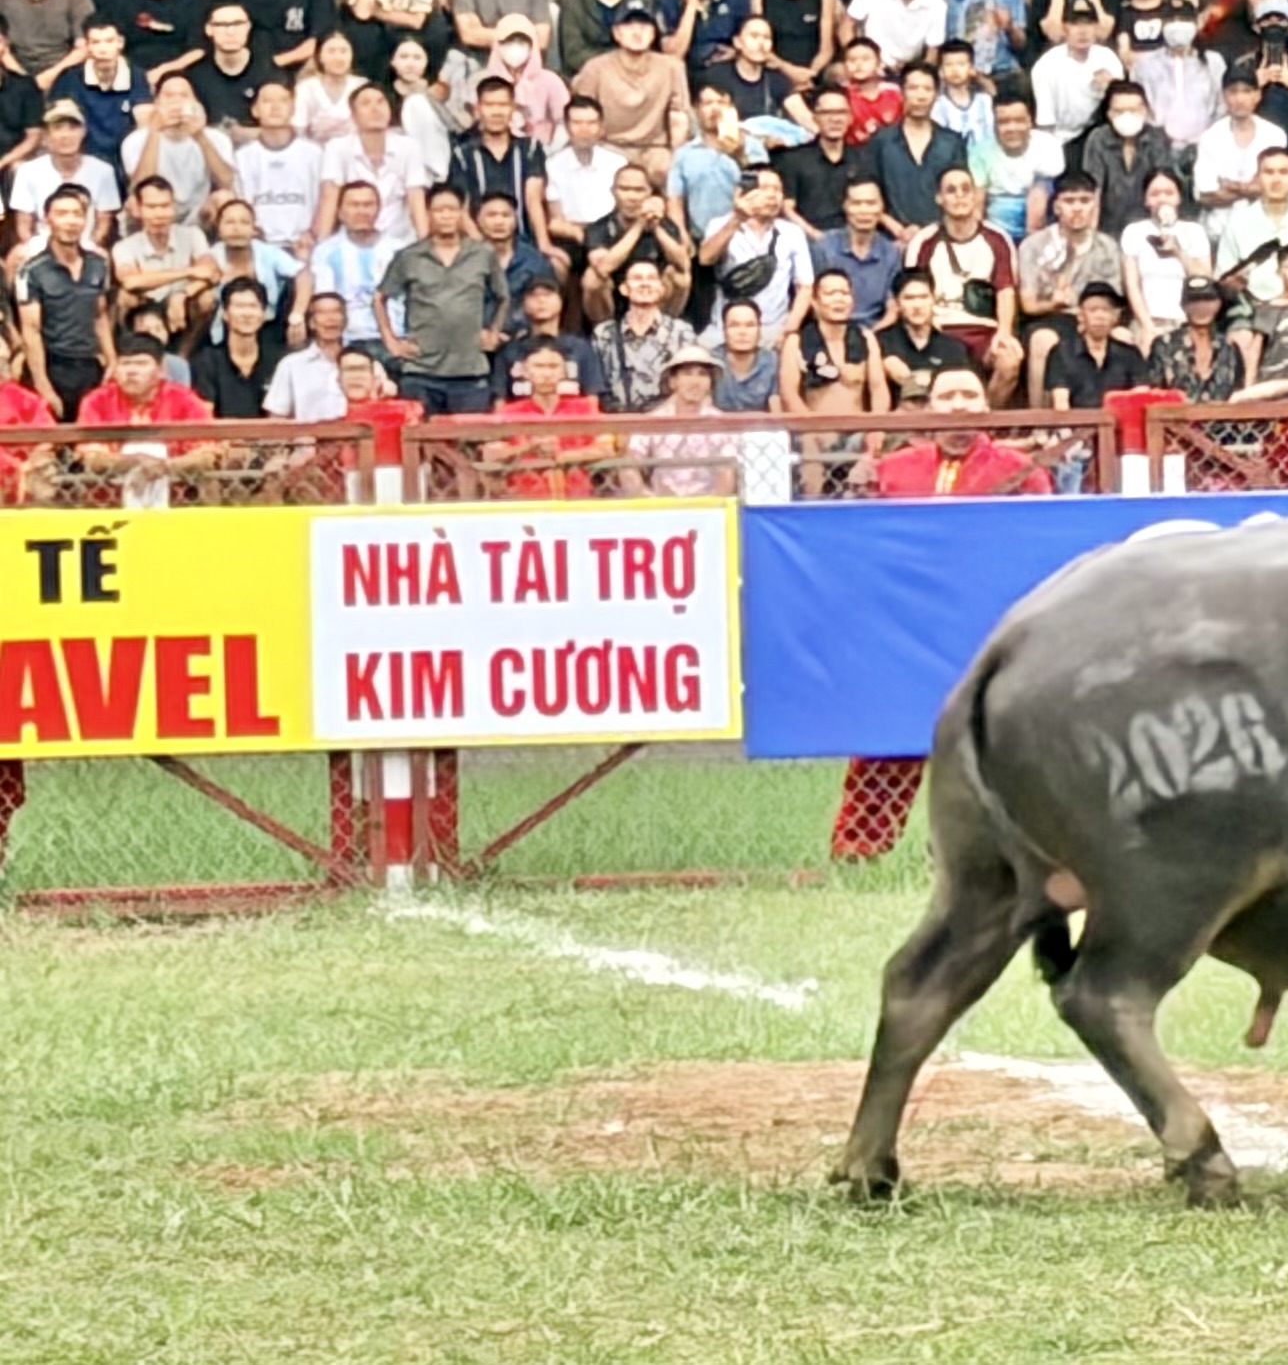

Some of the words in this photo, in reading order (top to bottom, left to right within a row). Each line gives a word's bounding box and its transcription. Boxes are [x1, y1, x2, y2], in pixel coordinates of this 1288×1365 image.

[25, 520, 129, 604] TẾ
[342, 527, 462, 606] NHÀ
[480, 525, 568, 603] TÀI
[589, 528, 697, 613] TRỢ
[345, 650, 464, 721] KIM
[489, 639, 702, 717] CƯƠNG
